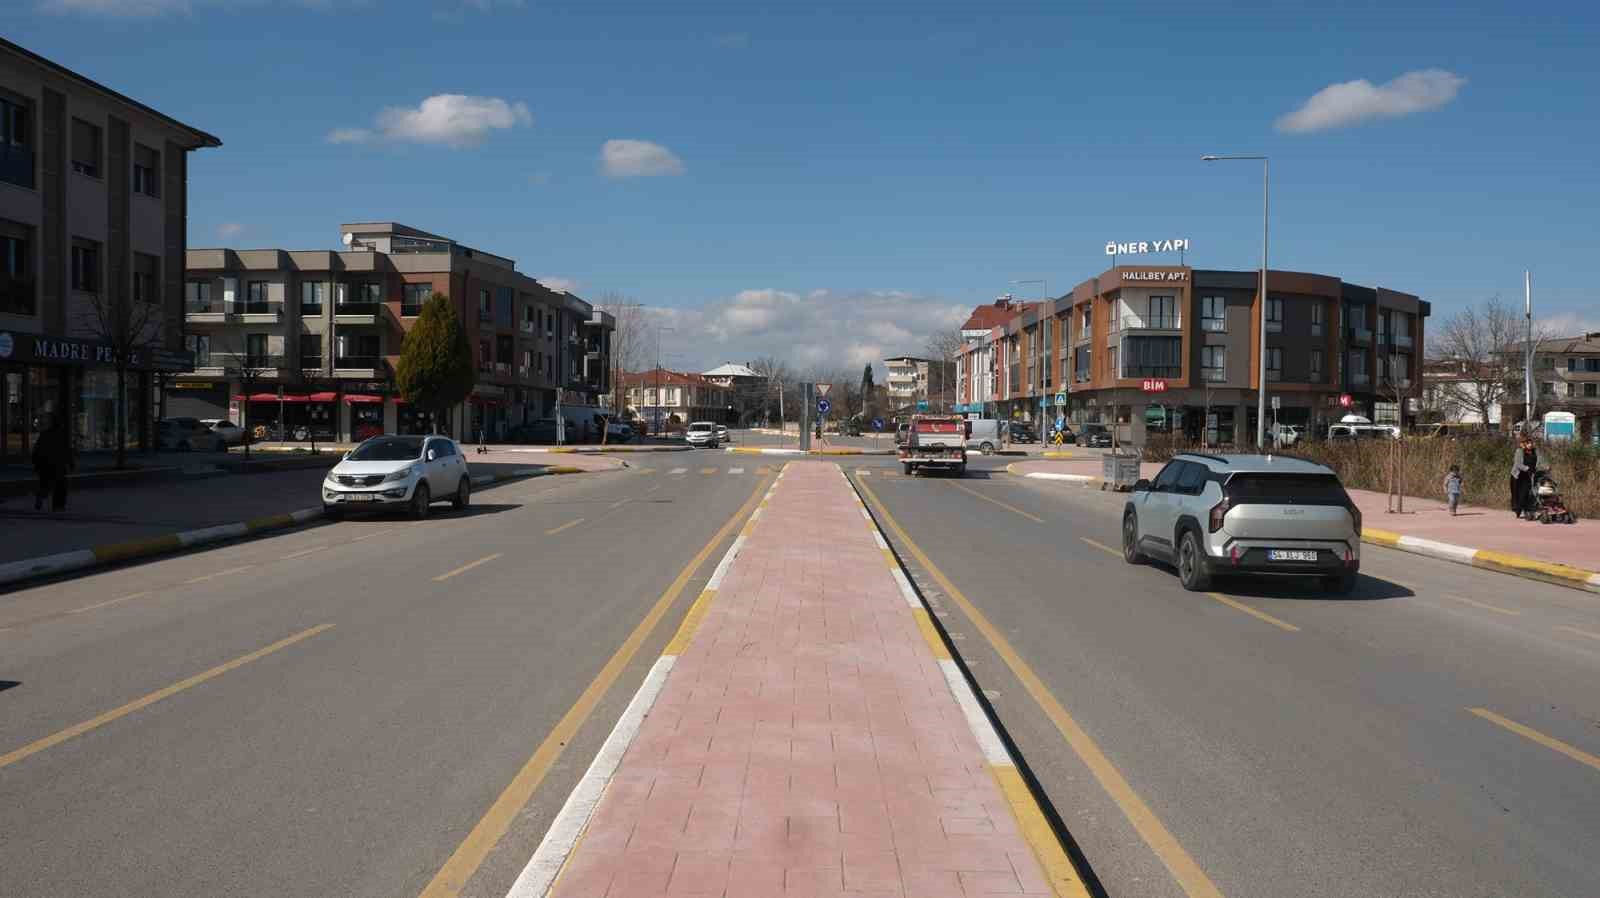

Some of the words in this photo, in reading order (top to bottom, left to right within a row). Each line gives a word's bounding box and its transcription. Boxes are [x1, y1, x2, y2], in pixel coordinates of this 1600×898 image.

[1106, 240, 1148, 255] ÖNER
[1152, 238, 1189, 252] YAPI
[1168, 271, 1189, 281] APT.
[33, 338, 89, 361] MADRE
[1143, 379, 1164, 391] BİM
